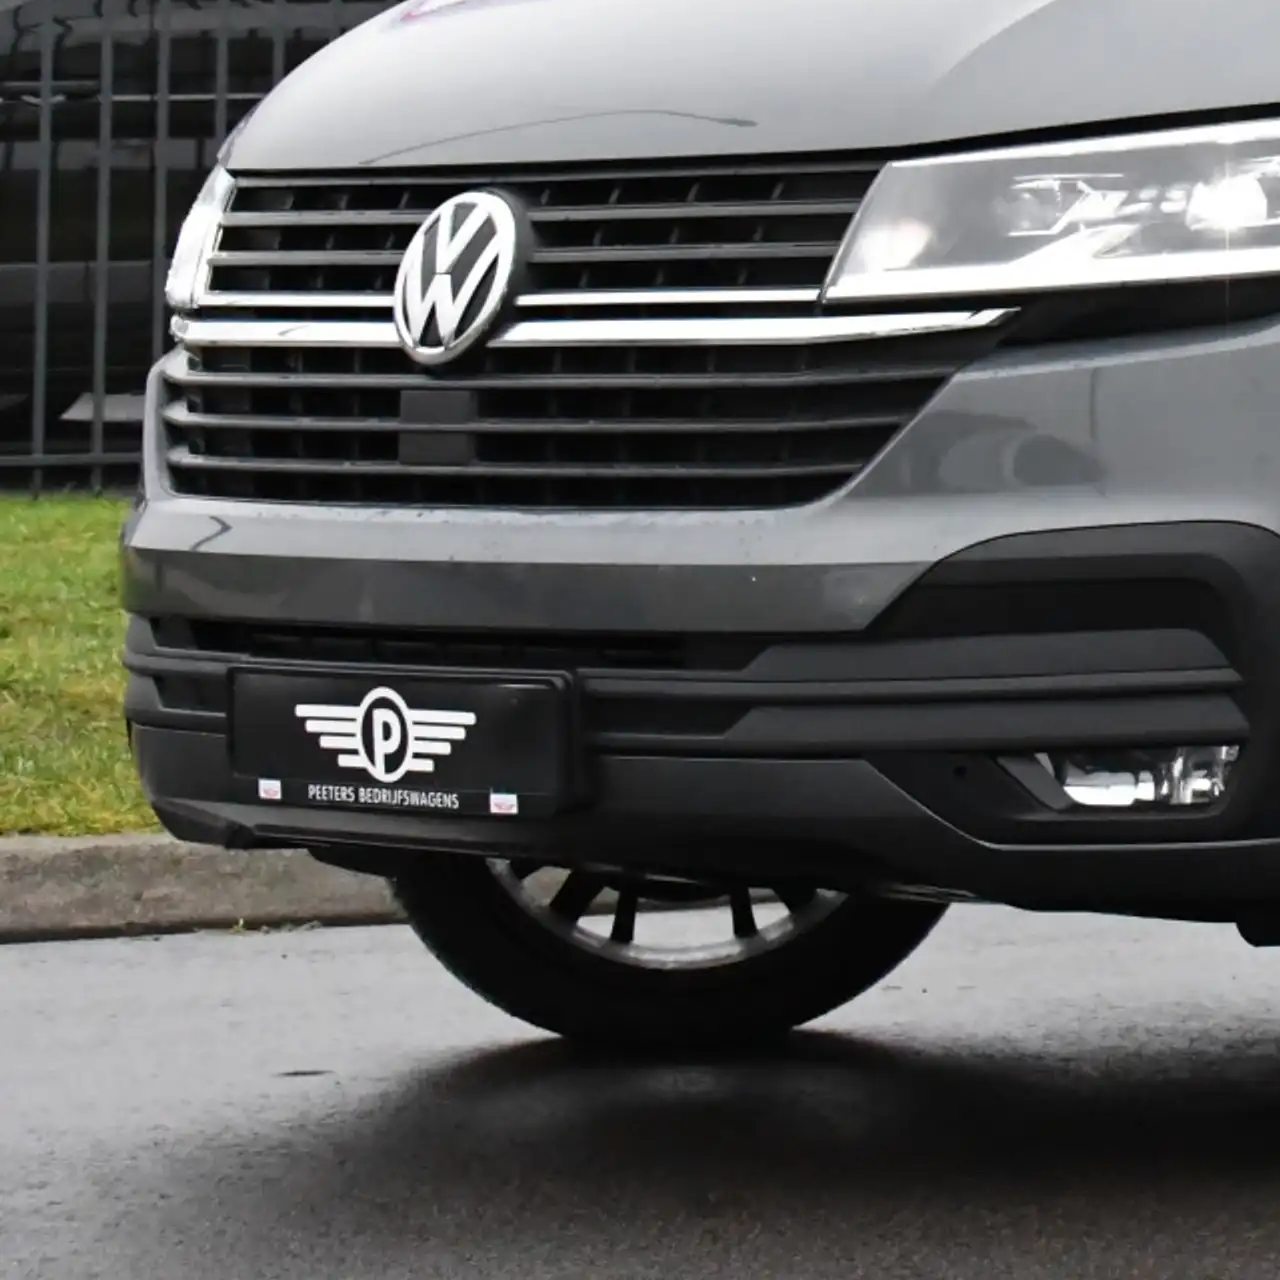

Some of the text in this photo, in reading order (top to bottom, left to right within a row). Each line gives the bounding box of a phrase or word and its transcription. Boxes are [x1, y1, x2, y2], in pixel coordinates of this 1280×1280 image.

[372, 708, 401, 775] P
[308, 784, 460, 810] PEETERS BEDRIJFSWAGENS
